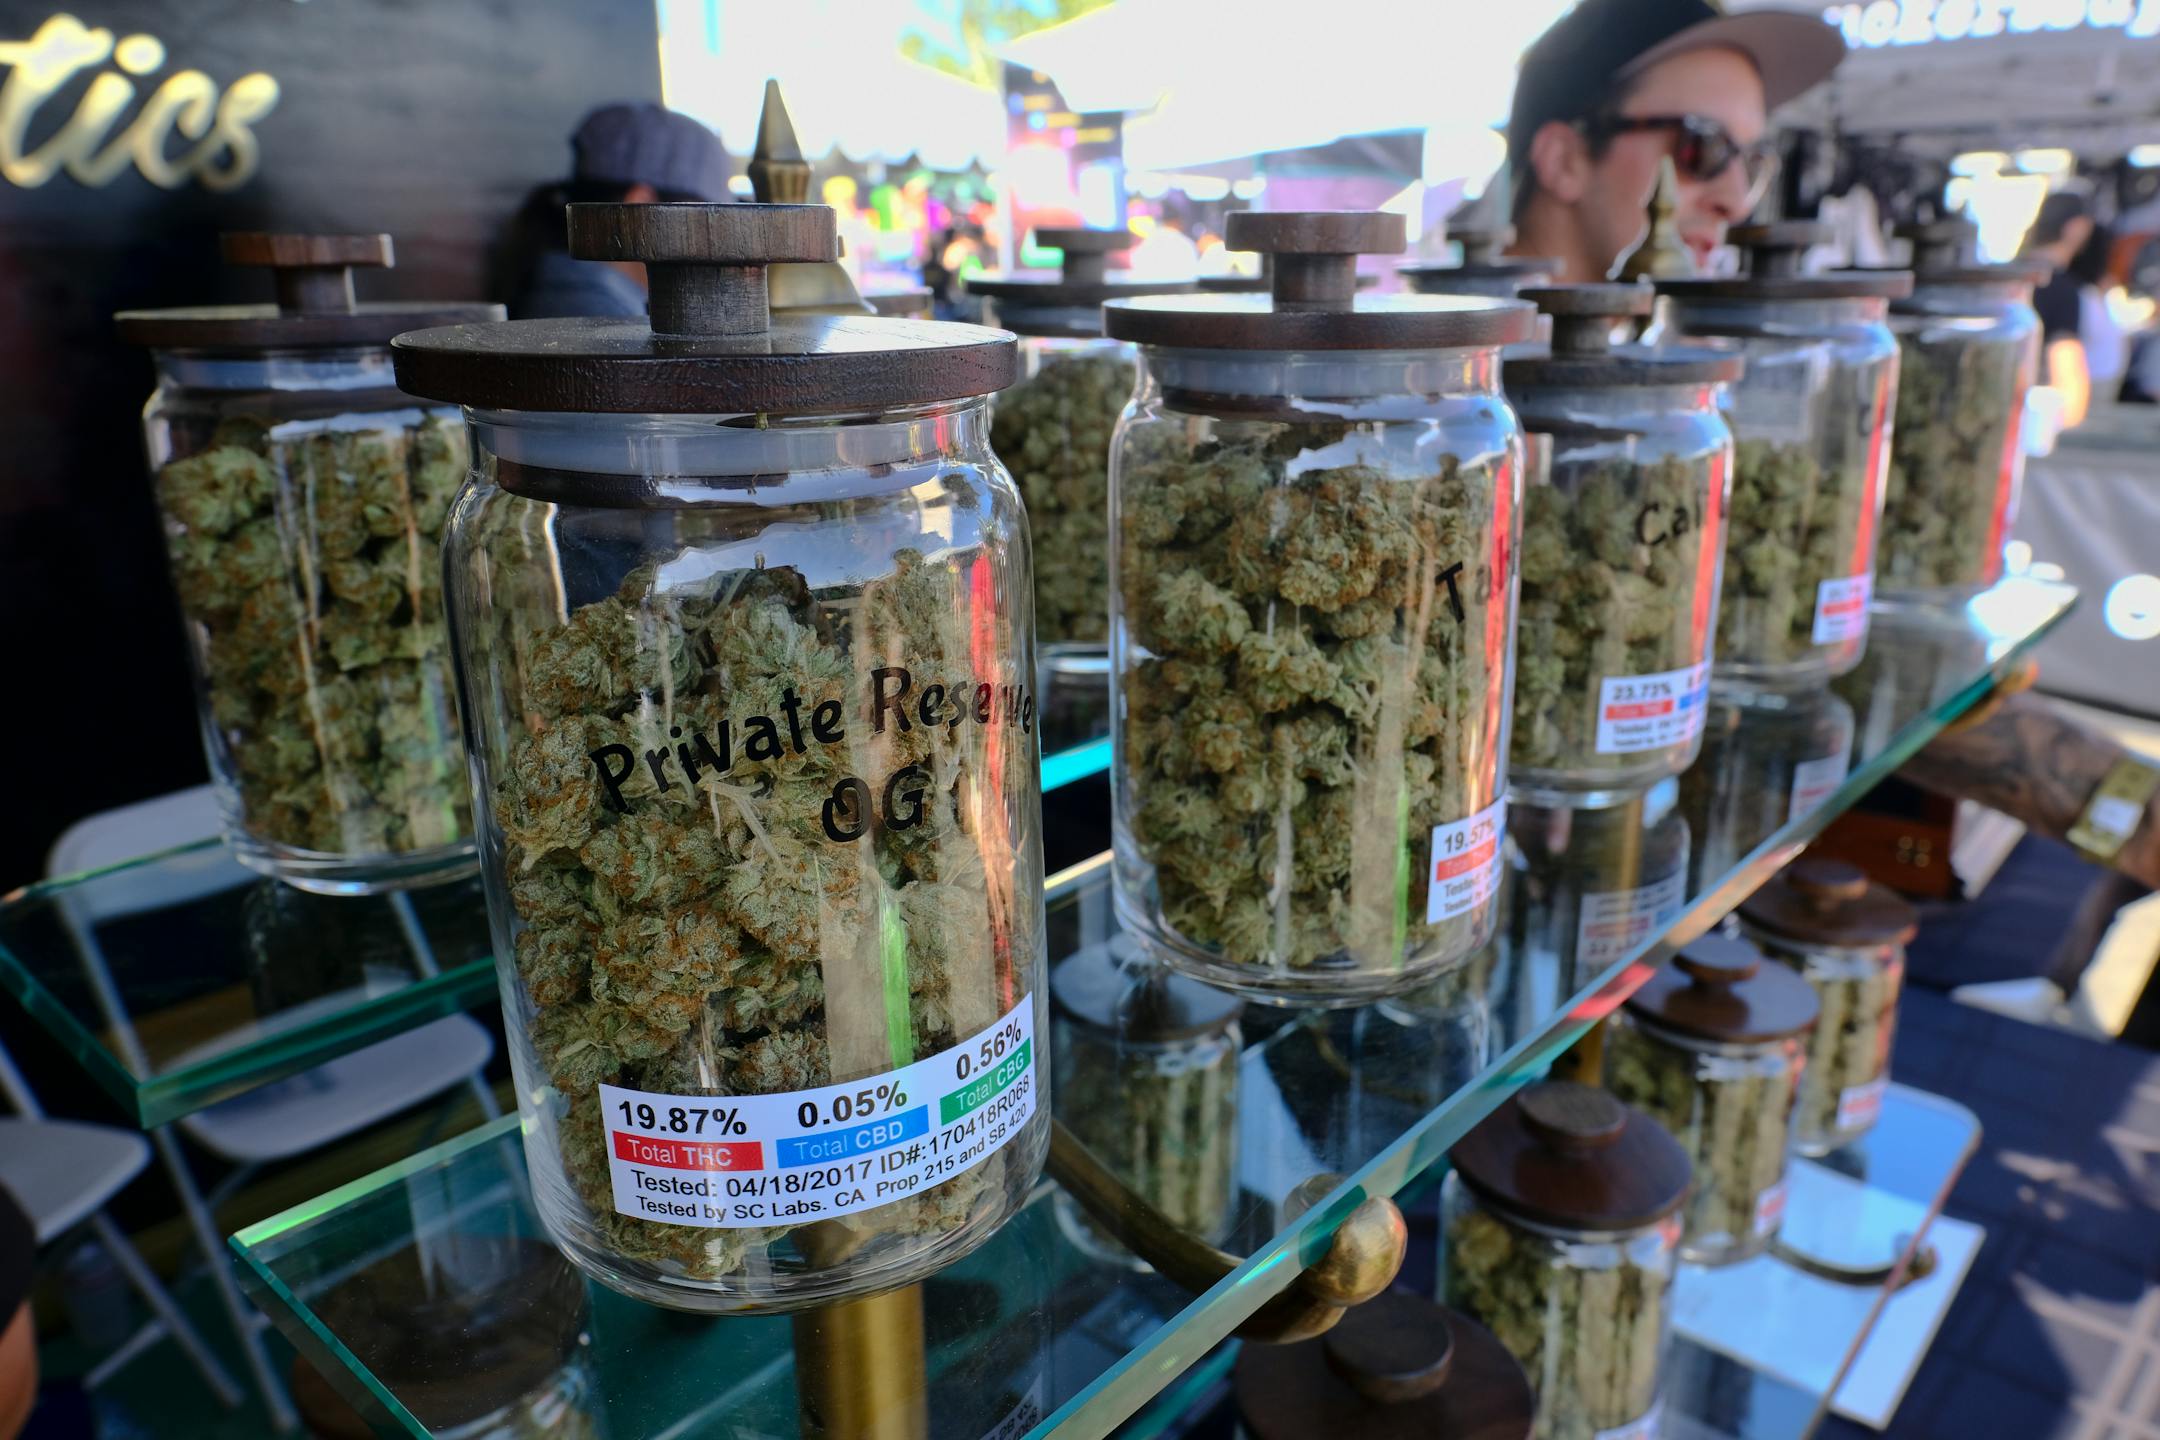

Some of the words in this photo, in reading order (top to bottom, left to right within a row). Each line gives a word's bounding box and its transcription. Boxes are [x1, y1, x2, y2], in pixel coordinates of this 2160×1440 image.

[590, 686, 846, 815] Private
[870, 665, 1032, 734] Reserve
[821, 762, 929, 843] OG
[618, 1100, 747, 1136] 19.87%
[797, 1080, 908, 1128] 0.05%
[956, 1017, 1022, 1081] 0.56%
[956, 1077, 993, 1111] Total
[996, 1052, 1024, 1087] CBG
[627, 1138, 677, 1164] Total
[682, 1146, 733, 1167] THC
[635, 1194, 697, 1219] Tested
[703, 1203, 727, 1223] by
[734, 1203, 765, 1220] SC
[772, 1199, 828, 1217] Labs.
[834, 1188, 866, 1207] CA
[876, 1174, 919, 1198] Prop
[924, 1155, 955, 1181] 215
[959, 1137, 985, 1165] and
[989, 1123, 1007, 1145] SB
[1008, 1102, 1027, 1129] 420
[794, 1134, 848, 1160] Total
[855, 1120, 904, 1149] CBD
[630, 1168, 719, 1198] Tested:
[726, 1159, 873, 1197] 04/18/2017
